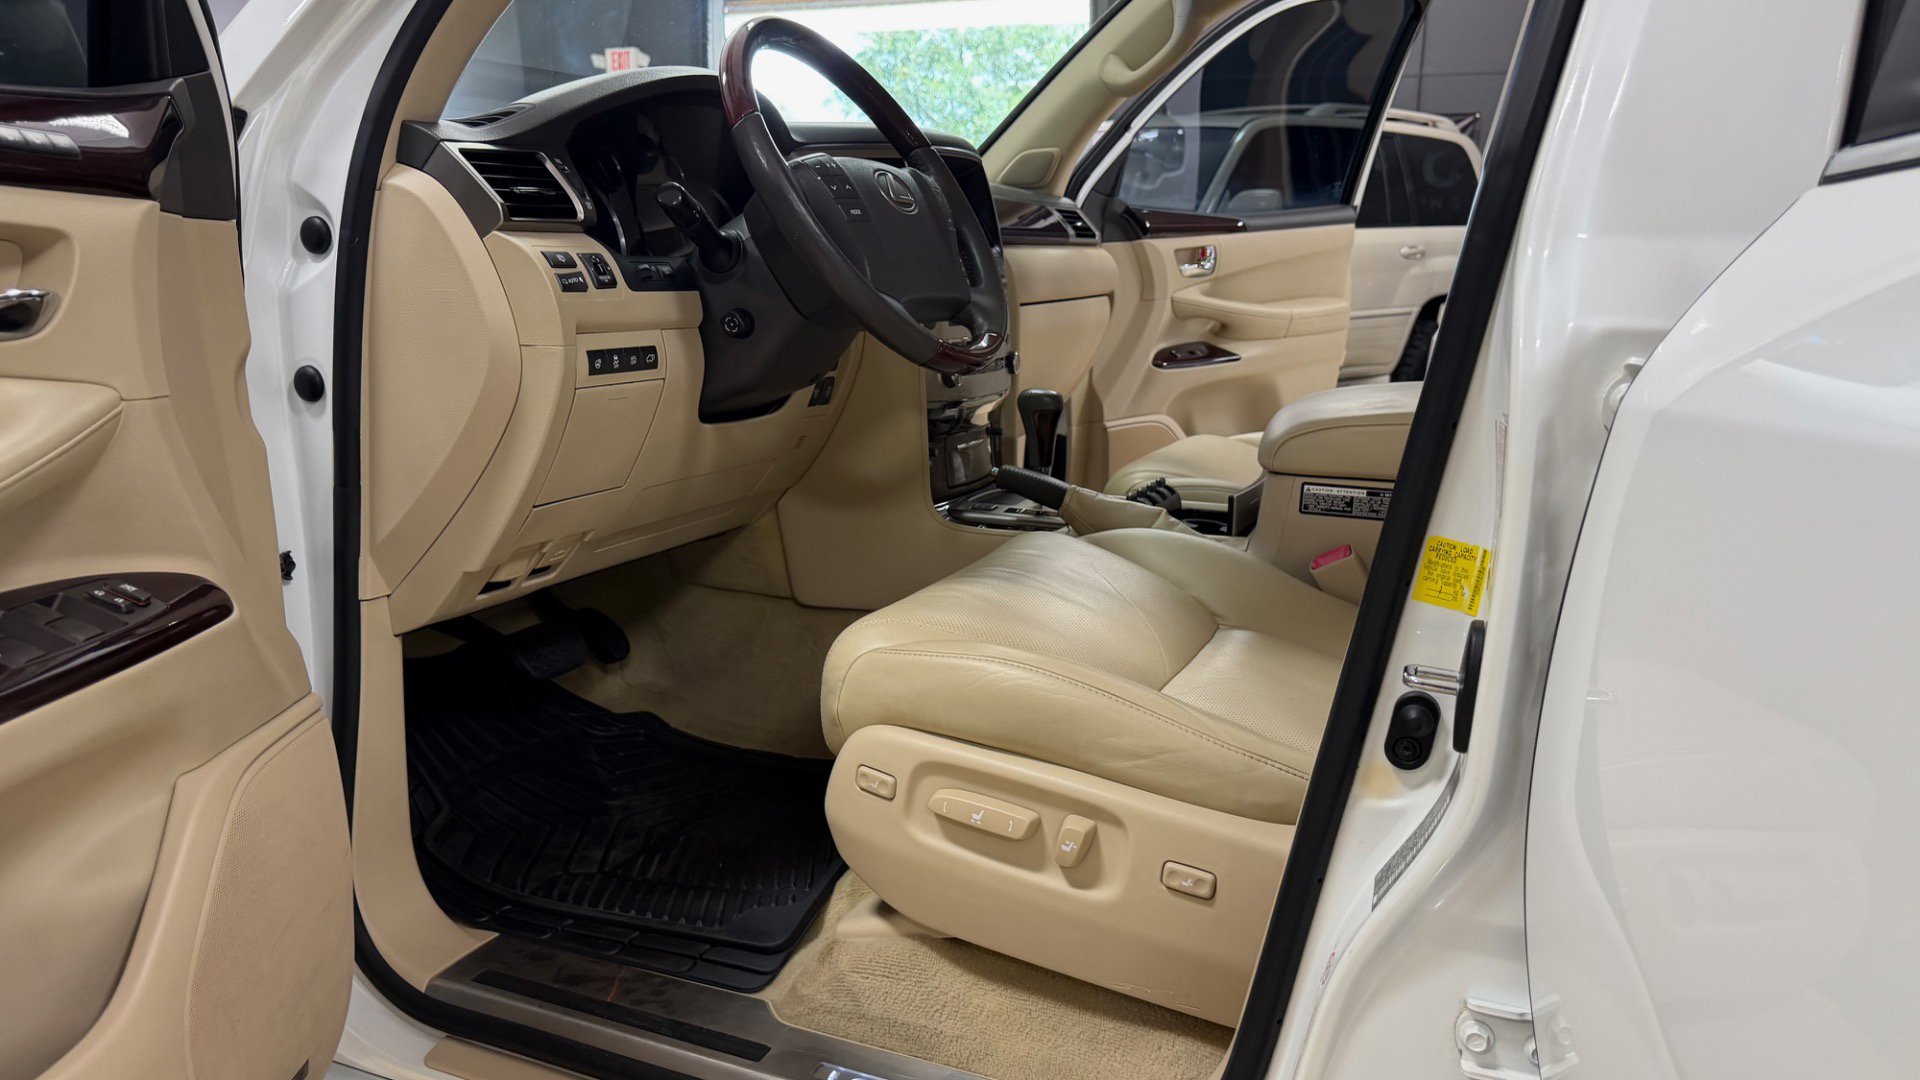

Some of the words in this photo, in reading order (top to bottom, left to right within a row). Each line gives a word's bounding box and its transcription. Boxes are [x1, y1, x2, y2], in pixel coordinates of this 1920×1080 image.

[611, 50, 631, 71] EXIT
[1436, 540, 1456, 550] CAUTION
[1460, 546, 1473, 555] LOAD
